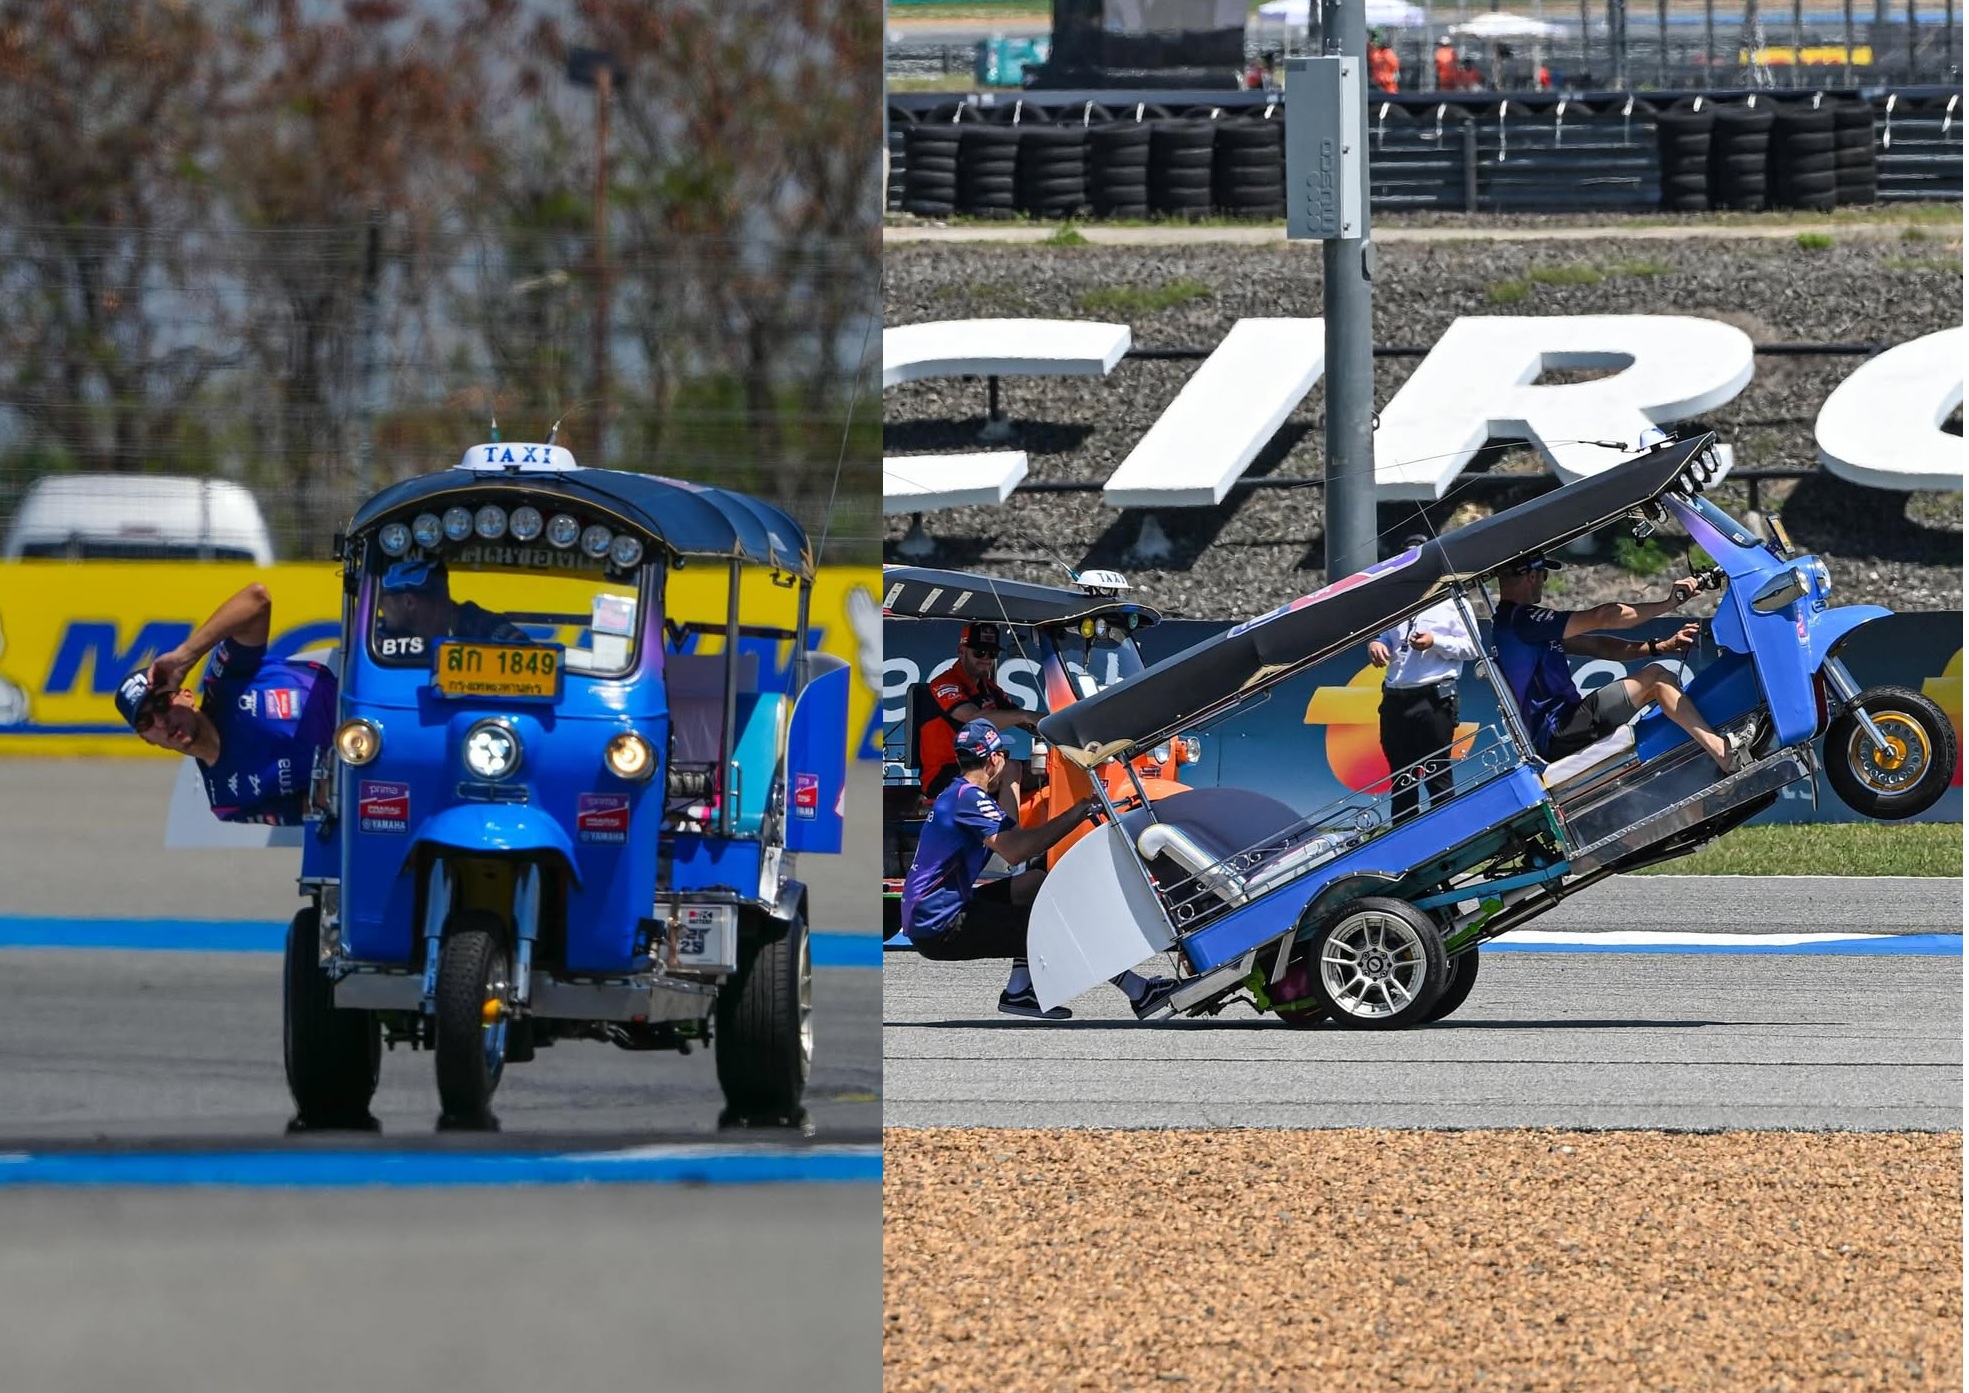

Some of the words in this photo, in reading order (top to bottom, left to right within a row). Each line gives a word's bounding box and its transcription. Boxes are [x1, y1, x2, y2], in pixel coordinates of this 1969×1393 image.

[484, 446, 552, 464] TAXI
[1097, 572, 1126, 584] TAXI
[382, 637, 424, 655] BTS
[498, 650, 555, 675] 1849
[369, 785, 398, 795] prima
[373, 819, 406, 829] YAMAHA
[590, 831, 624, 841] YAMAHA
